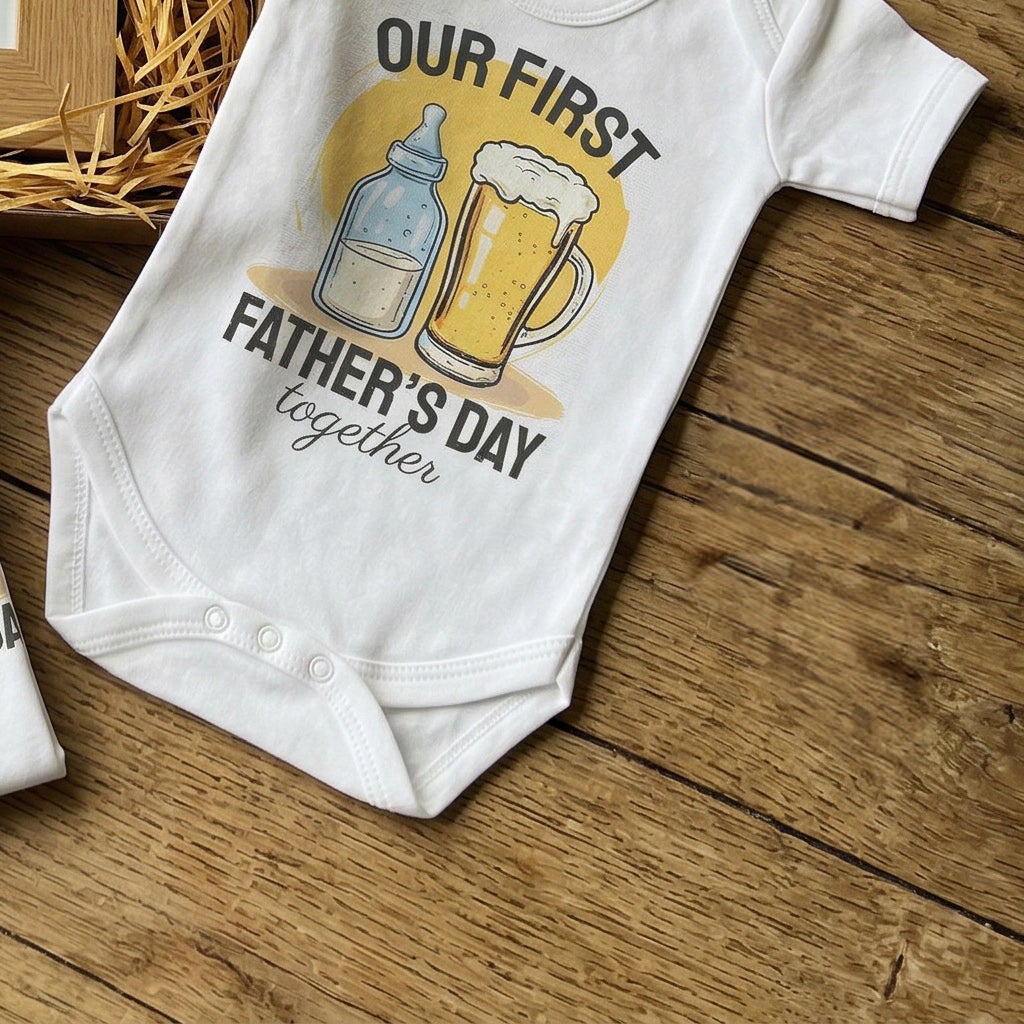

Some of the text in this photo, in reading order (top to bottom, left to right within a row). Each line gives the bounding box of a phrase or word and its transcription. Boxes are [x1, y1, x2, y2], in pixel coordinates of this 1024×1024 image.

[376, 17, 661, 180] OUR FIRST
[221, 291, 546, 481] FATHER’S DAY
[275, 381, 440, 485] together
